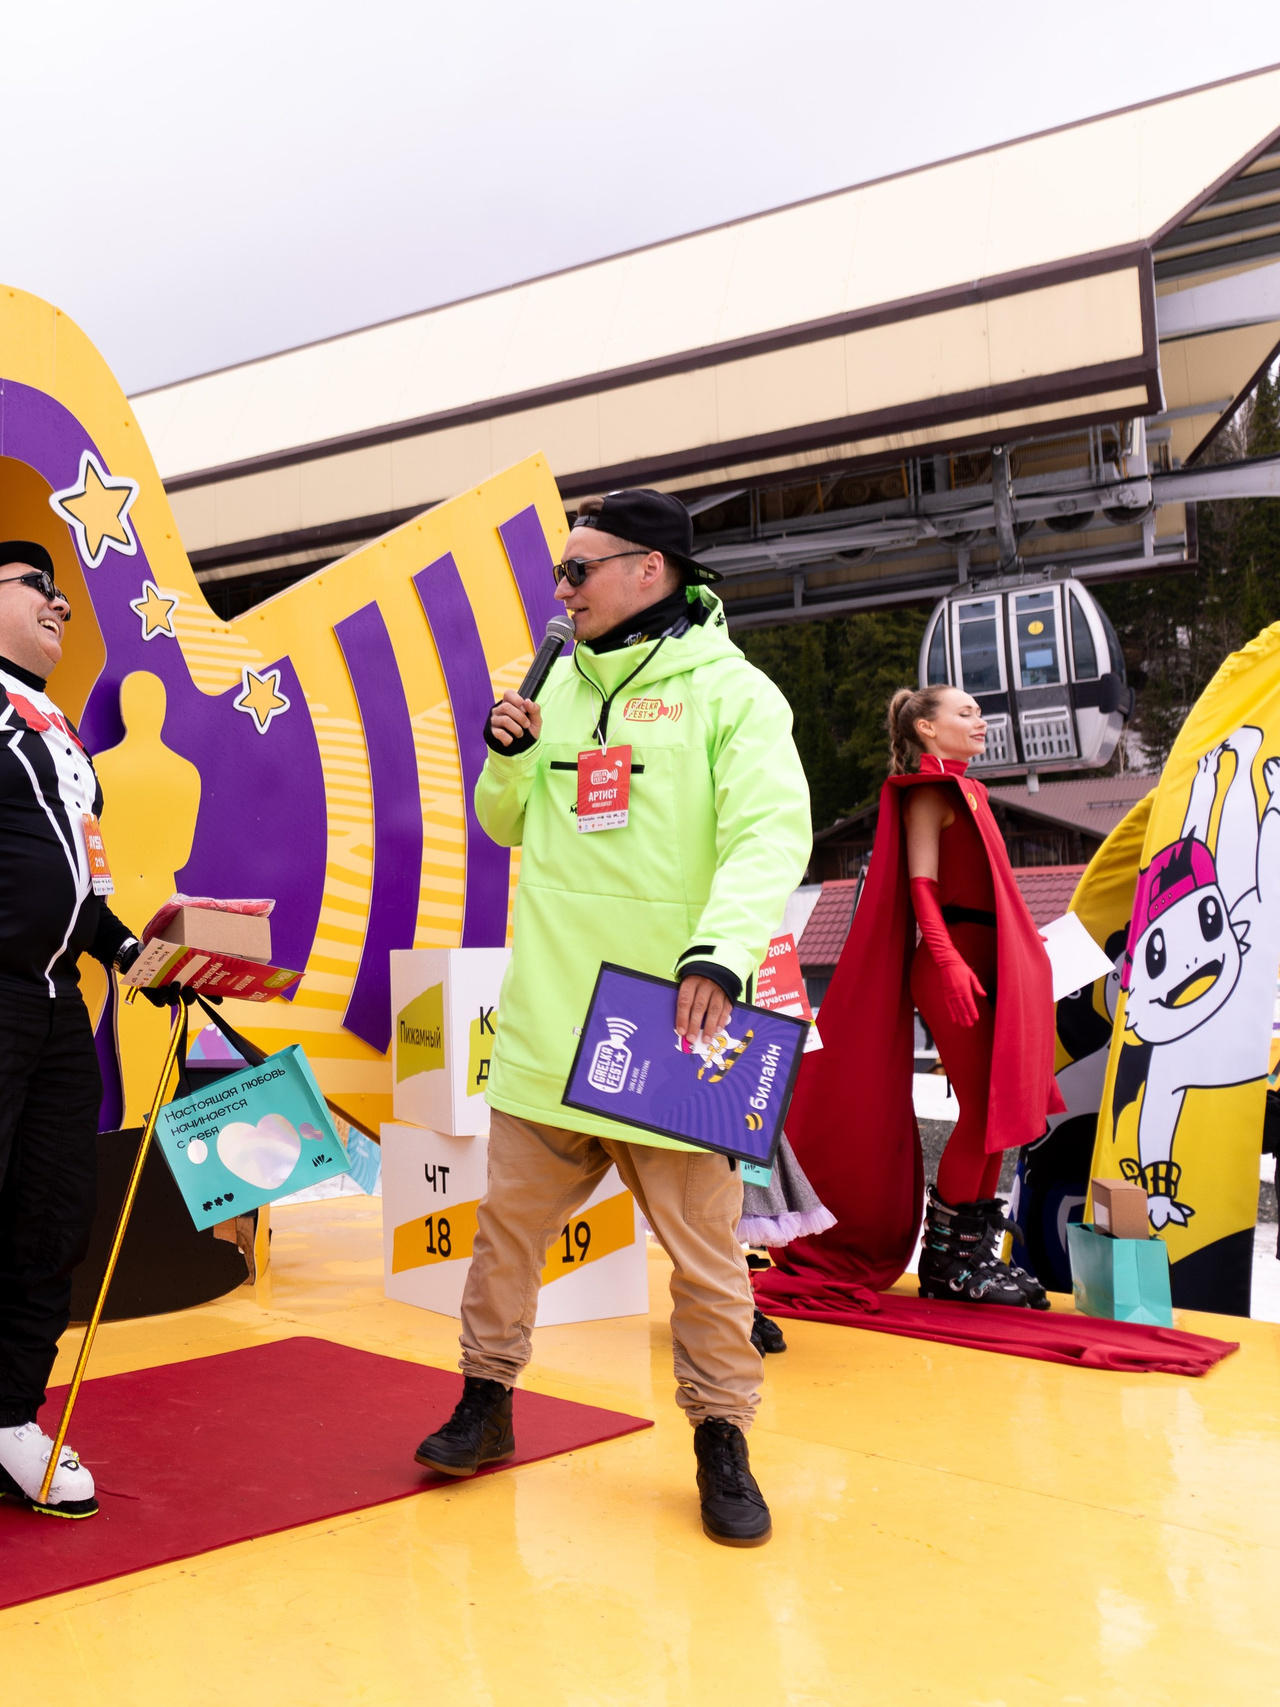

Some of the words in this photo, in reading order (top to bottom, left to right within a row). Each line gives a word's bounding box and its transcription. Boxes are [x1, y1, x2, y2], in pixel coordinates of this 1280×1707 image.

[588, 788, 618, 802] АРТИСТ
[768, 942, 792, 958] 2024
[400, 1020, 442, 1050] Пижамный
[593, 1046, 614, 1084] GRELKA
[606, 1060, 624, 1088] FEST
[749, 1043, 782, 1110] билайн
[164, 1085, 239, 1124] Настоящая
[241, 1068, 286, 1093] любовь
[170, 1098, 248, 1137] начинается
[424, 1163, 450, 1194] ЧТ
[425, 1215, 451, 1258] 18
[561, 1221, 591, 1263] 19
